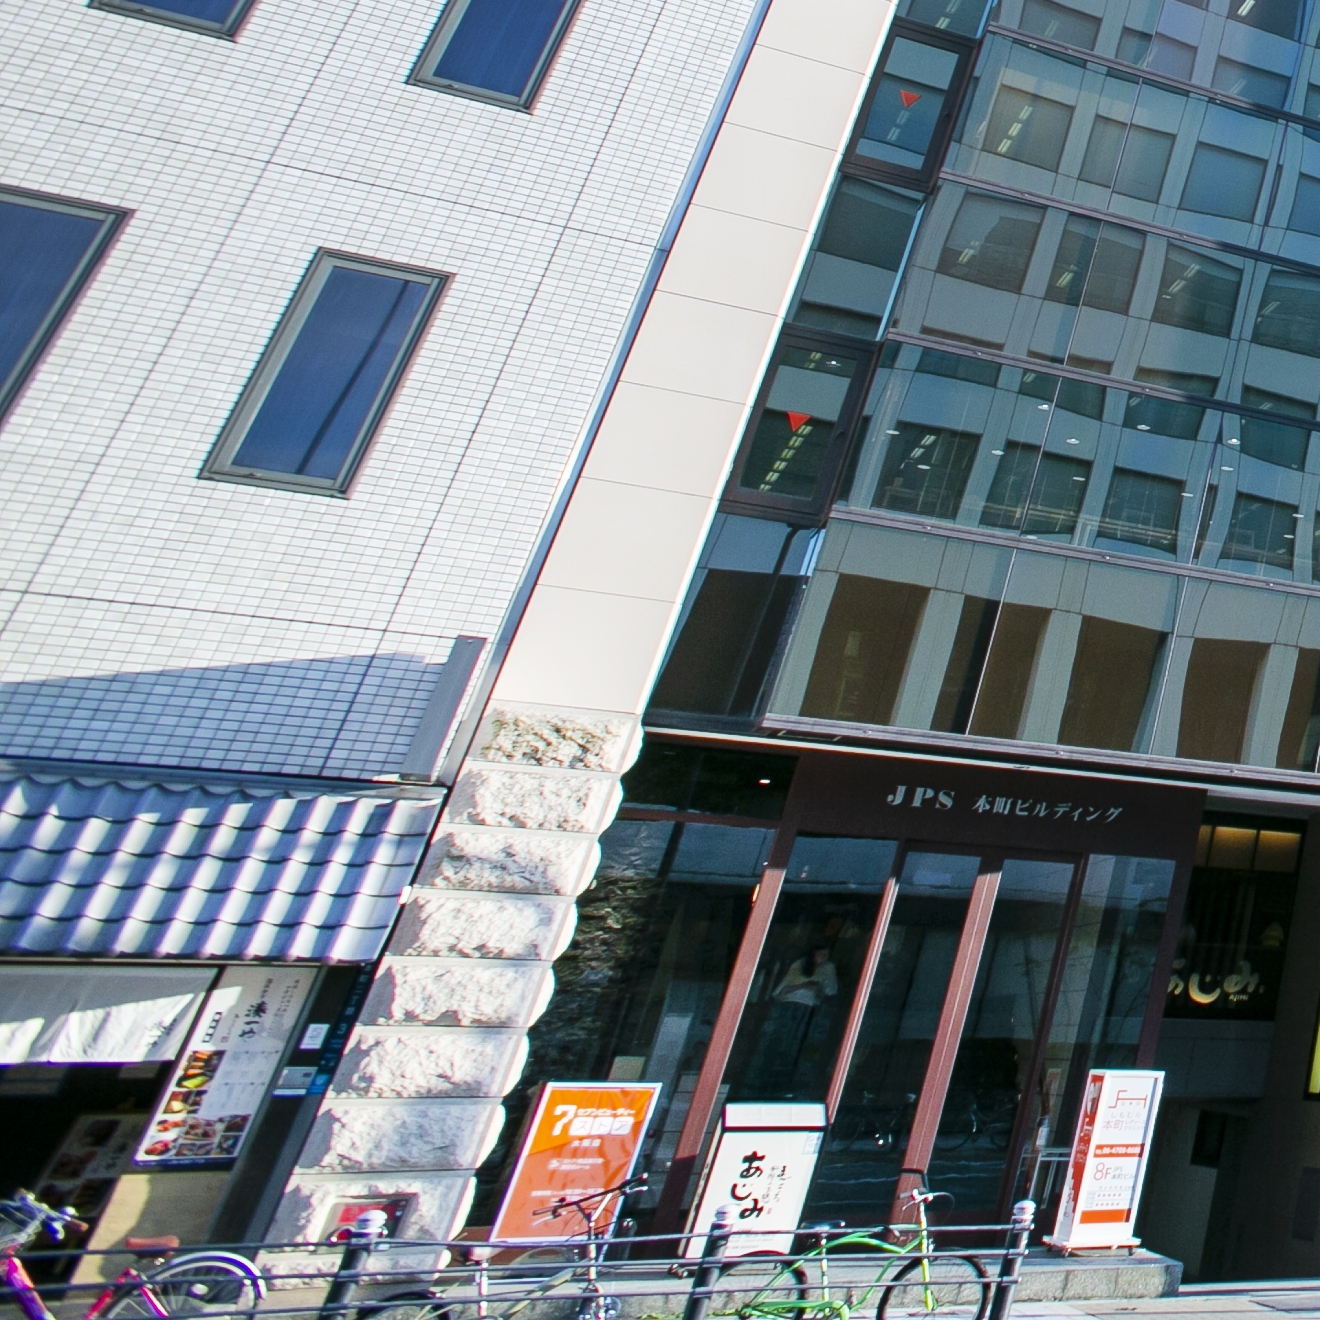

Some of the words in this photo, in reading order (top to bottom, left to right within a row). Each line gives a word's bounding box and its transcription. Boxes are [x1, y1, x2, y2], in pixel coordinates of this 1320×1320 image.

[886, 785, 955, 810] JPS
[971, 794, 1123, 823] 本町ビルディング
[552, 1104, 577, 1136] 7
[568, 1117, 634, 1136] ストア
[1102, 1120, 1123, 1130] 本町
[1094, 1162, 1111, 1180] 8F
[730, 1150, 766, 1220] あじみ
